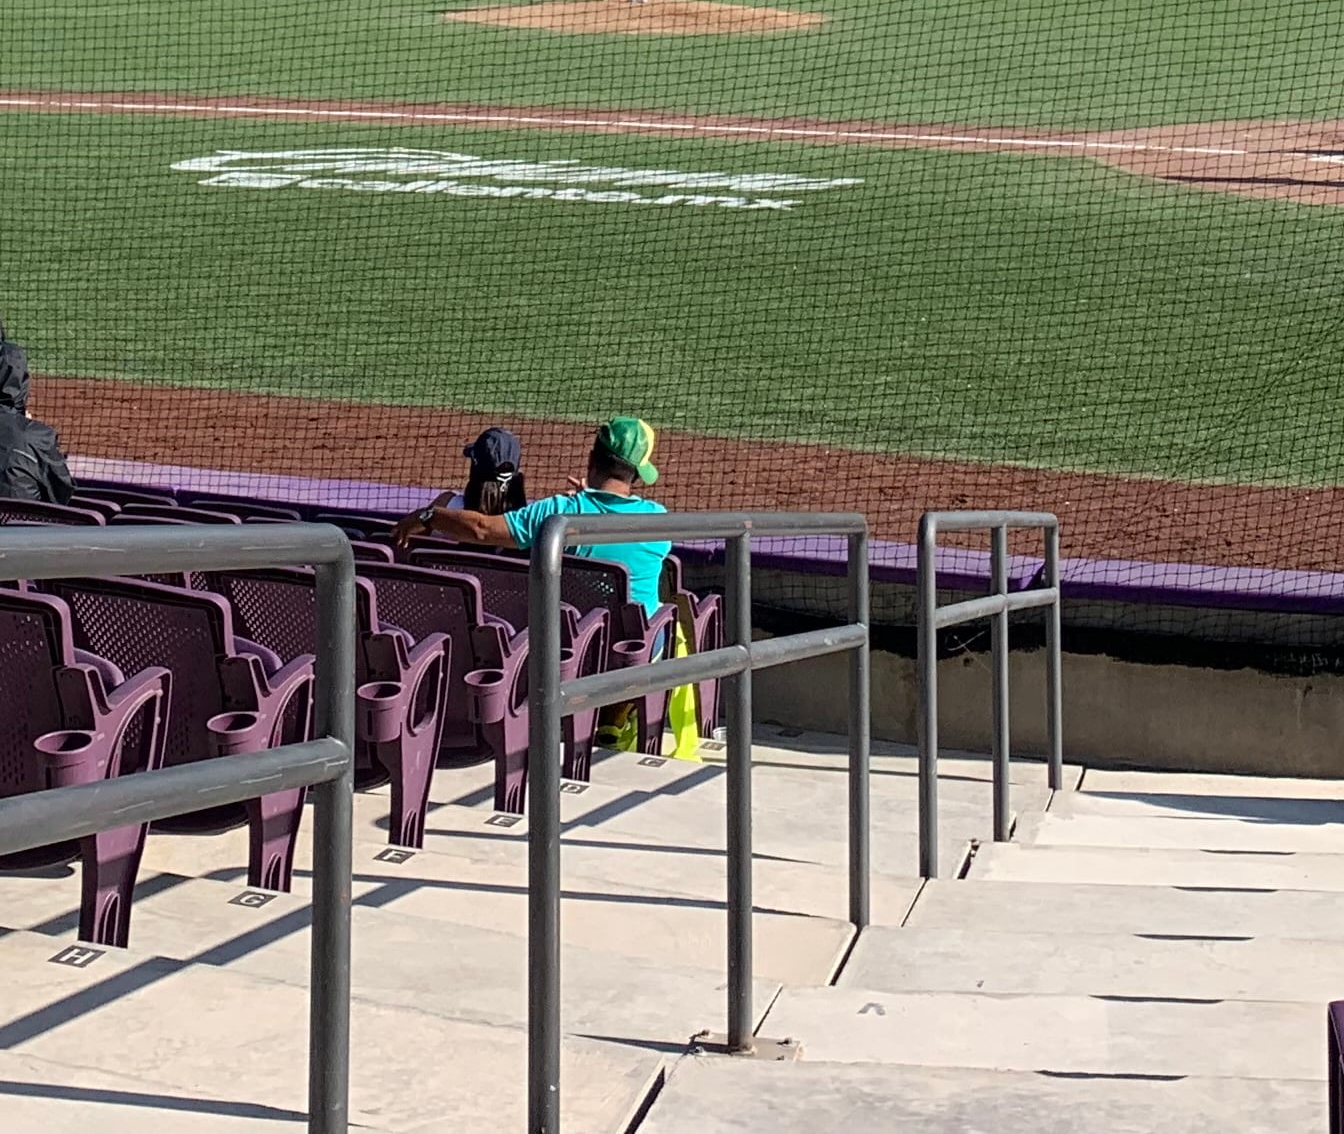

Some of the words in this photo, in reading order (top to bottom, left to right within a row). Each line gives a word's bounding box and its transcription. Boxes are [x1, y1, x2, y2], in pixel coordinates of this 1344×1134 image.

[492, 816, 514, 826] E
[382, 851, 407, 862] F
[239, 894, 266, 906] G
[59, 948, 96, 964] H
